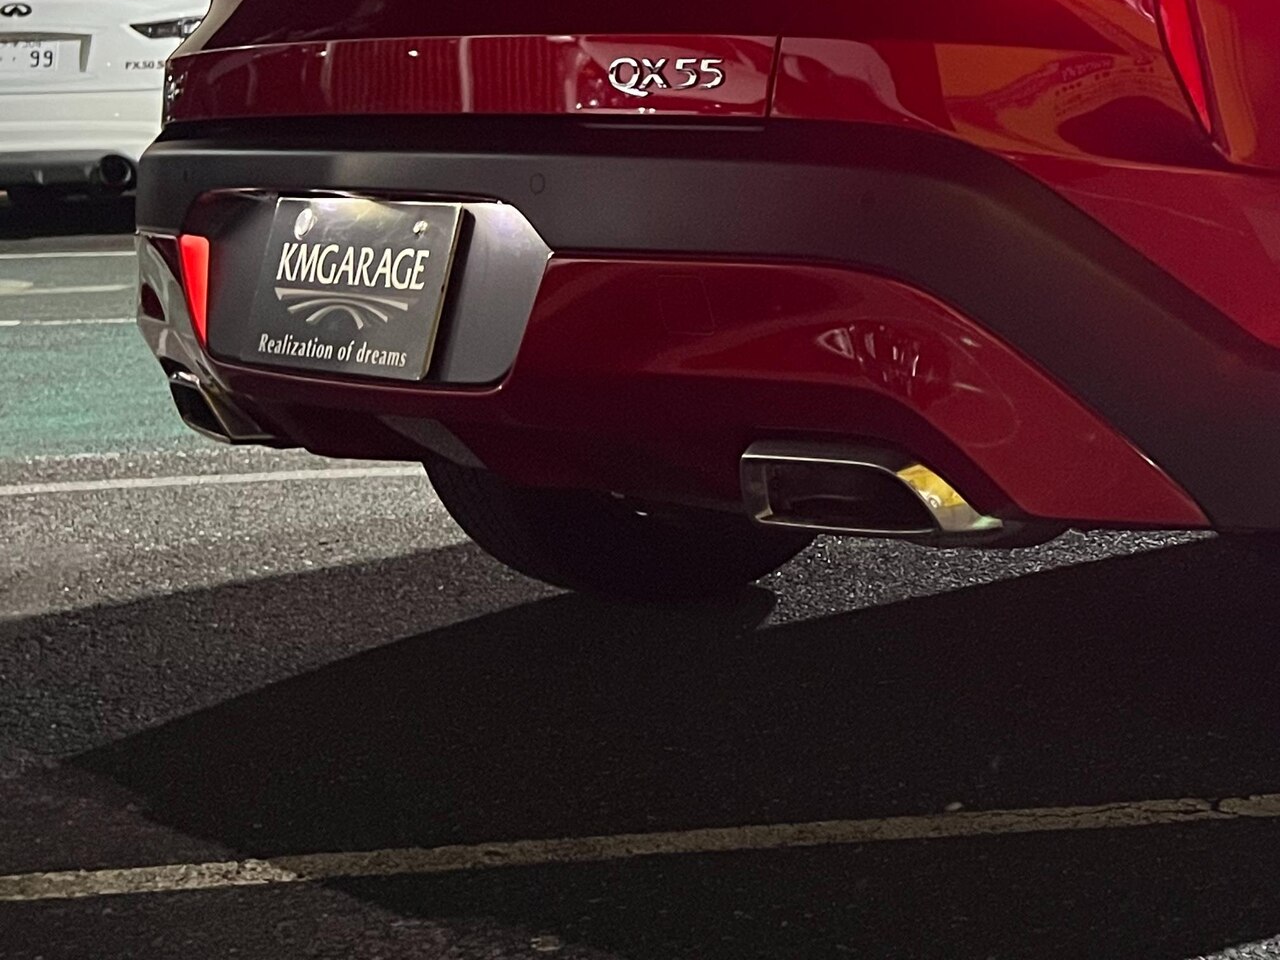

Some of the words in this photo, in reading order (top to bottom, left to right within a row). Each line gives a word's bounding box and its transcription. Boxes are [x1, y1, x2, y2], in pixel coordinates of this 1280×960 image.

[30, 50, 53, 68] 99
[276, 242, 430, 290] KMGARAGE
[258, 333, 332, 360] Realization
[337, 341, 355, 361] of
[356, 341, 407, 368] dreams
